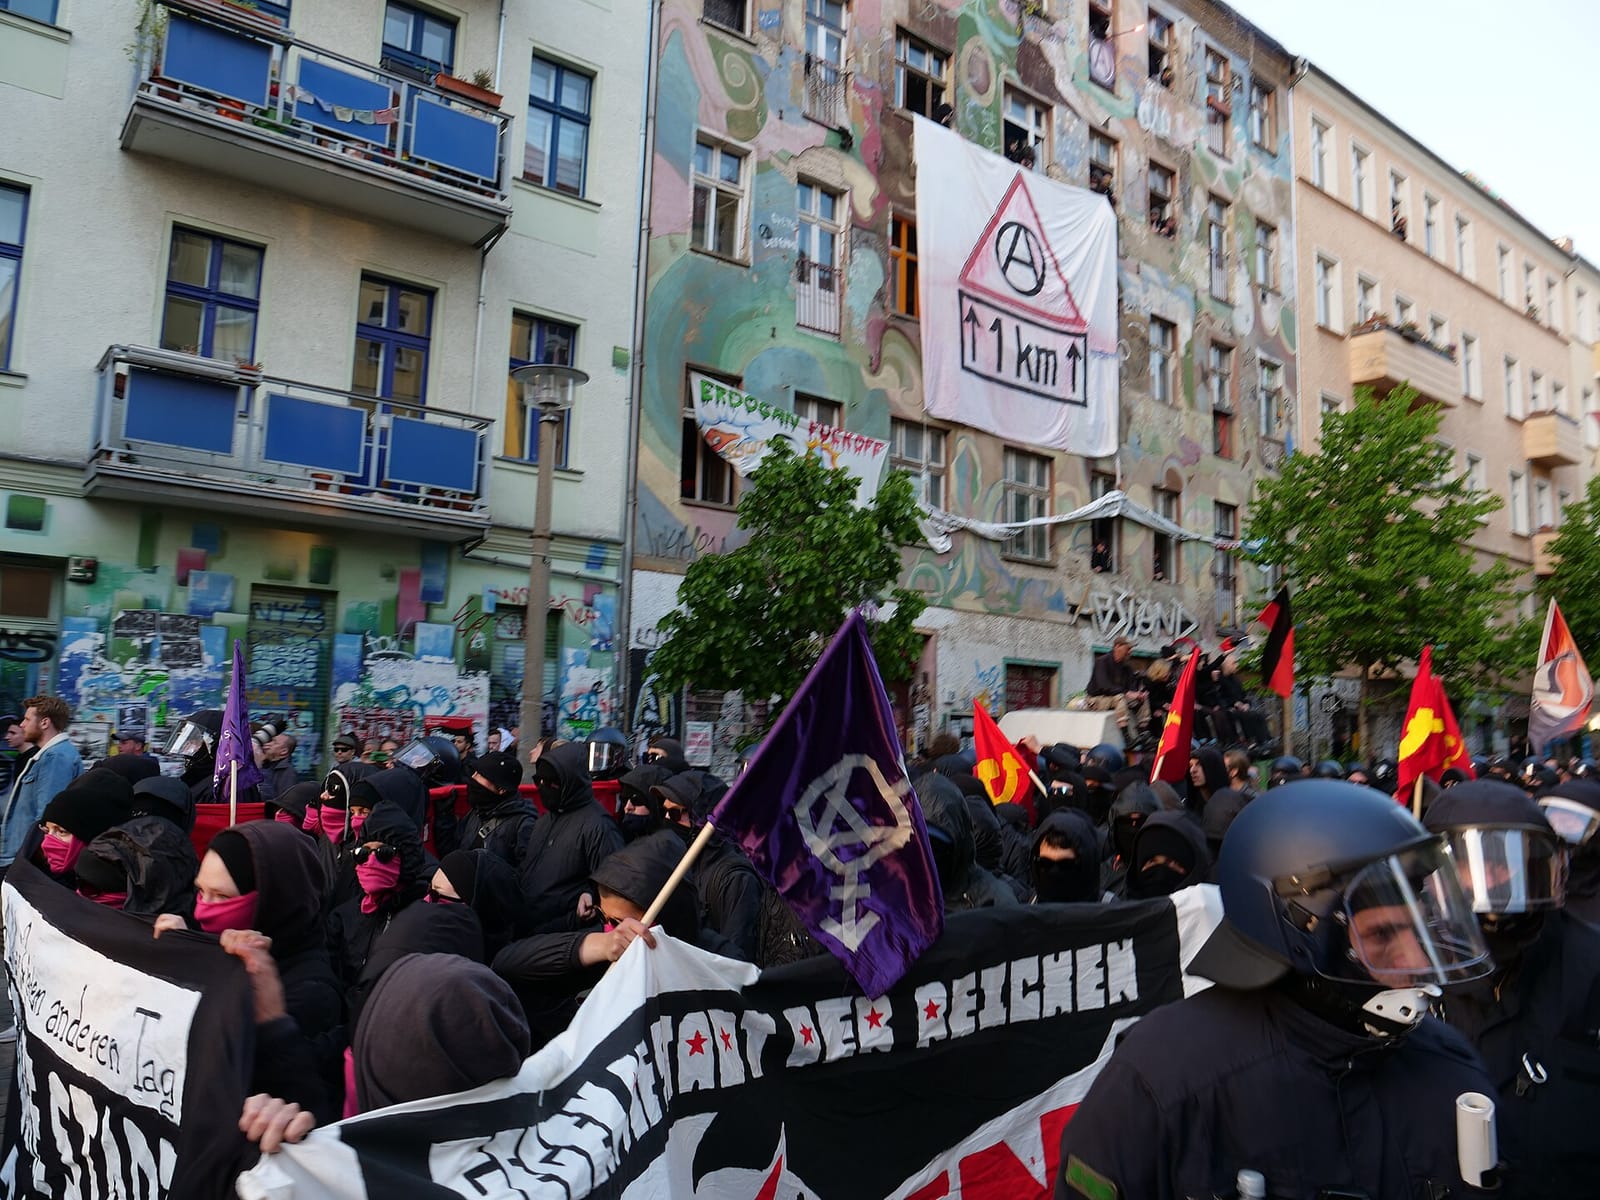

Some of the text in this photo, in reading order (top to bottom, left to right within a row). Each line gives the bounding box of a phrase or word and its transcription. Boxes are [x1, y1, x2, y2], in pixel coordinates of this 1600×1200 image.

[989, 317, 1057, 387] 1 km
[45, 984, 175, 1118] anderen Tag
[783, 996, 894, 1067] DER
[915, 938, 1138, 1048] REICHEN
